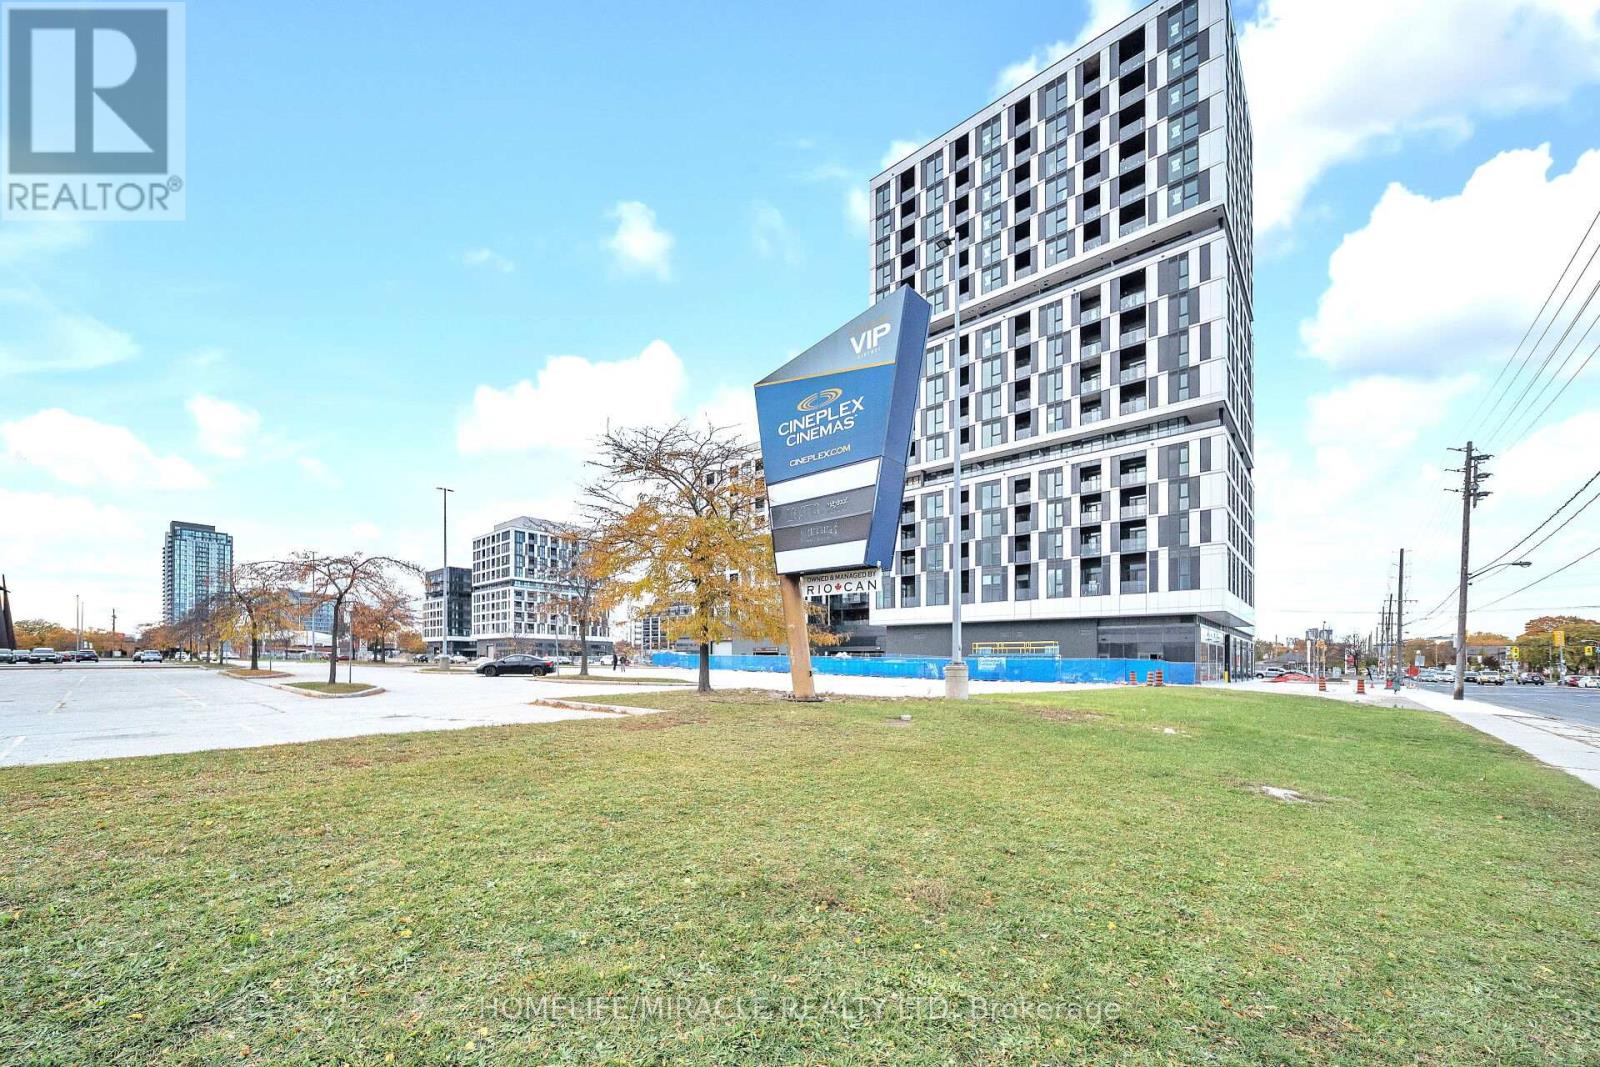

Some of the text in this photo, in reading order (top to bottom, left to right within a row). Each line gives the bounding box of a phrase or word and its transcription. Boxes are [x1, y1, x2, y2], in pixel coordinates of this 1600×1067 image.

[850, 322, 892, 354] VIP
[778, 396, 865, 436] CINEPLEX
[786, 417, 856, 447] CINEMAS
[789, 444, 851, 467] CINEPLEX.COM
[806, 575, 829, 583] OWNED
[834, 571, 867, 580] MANAGED
[867, 569, 877, 577] BY
